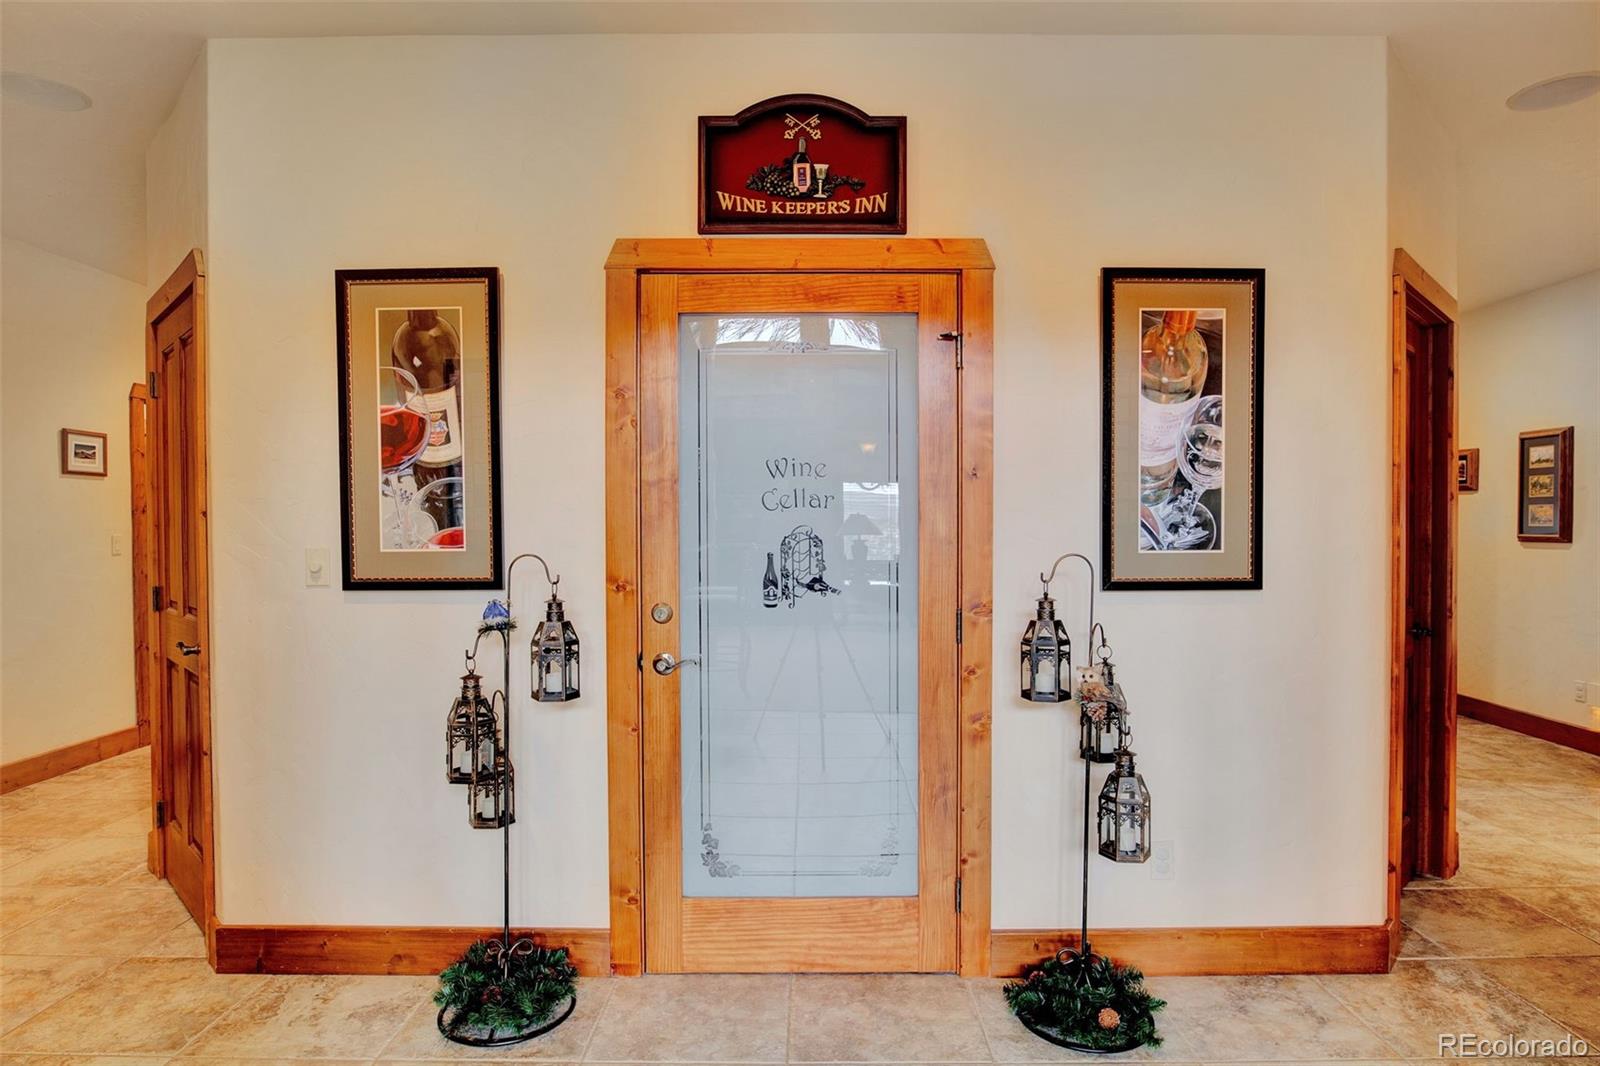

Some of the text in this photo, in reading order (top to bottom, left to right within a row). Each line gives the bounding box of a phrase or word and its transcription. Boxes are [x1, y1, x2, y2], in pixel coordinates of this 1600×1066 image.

[716, 191, 767, 214] WINE
[854, 192, 888, 214] INN
[766, 457, 827, 479] Wine
[761, 487, 835, 512] Cellar
